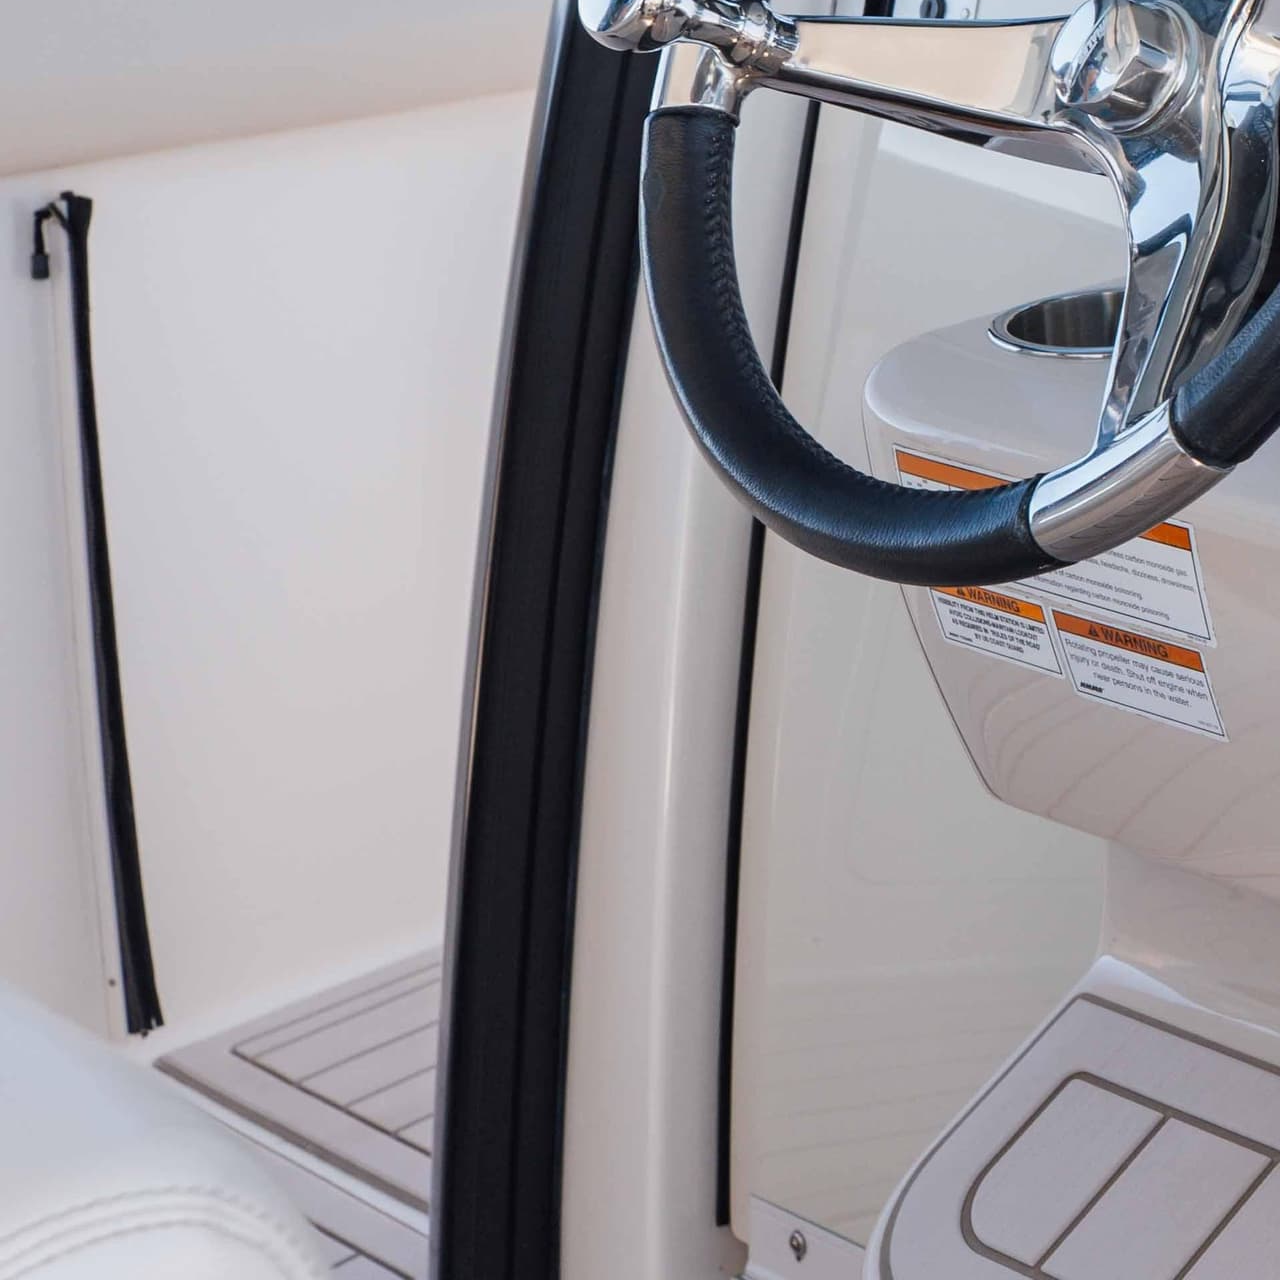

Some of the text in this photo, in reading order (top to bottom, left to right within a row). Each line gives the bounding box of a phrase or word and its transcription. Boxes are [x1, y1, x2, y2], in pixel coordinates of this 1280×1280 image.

[966, 587, 1021, 613] WARNING
[1101, 626, 1169, 658] WARNING
[1065, 638, 1206, 689] Rotating propeller may cause serious
[1112, 677, 1144, 695] persons
[1126, 668, 1145, 683] Shut
[1158, 679, 1186, 696] engine
[1186, 687, 1210, 702] when
